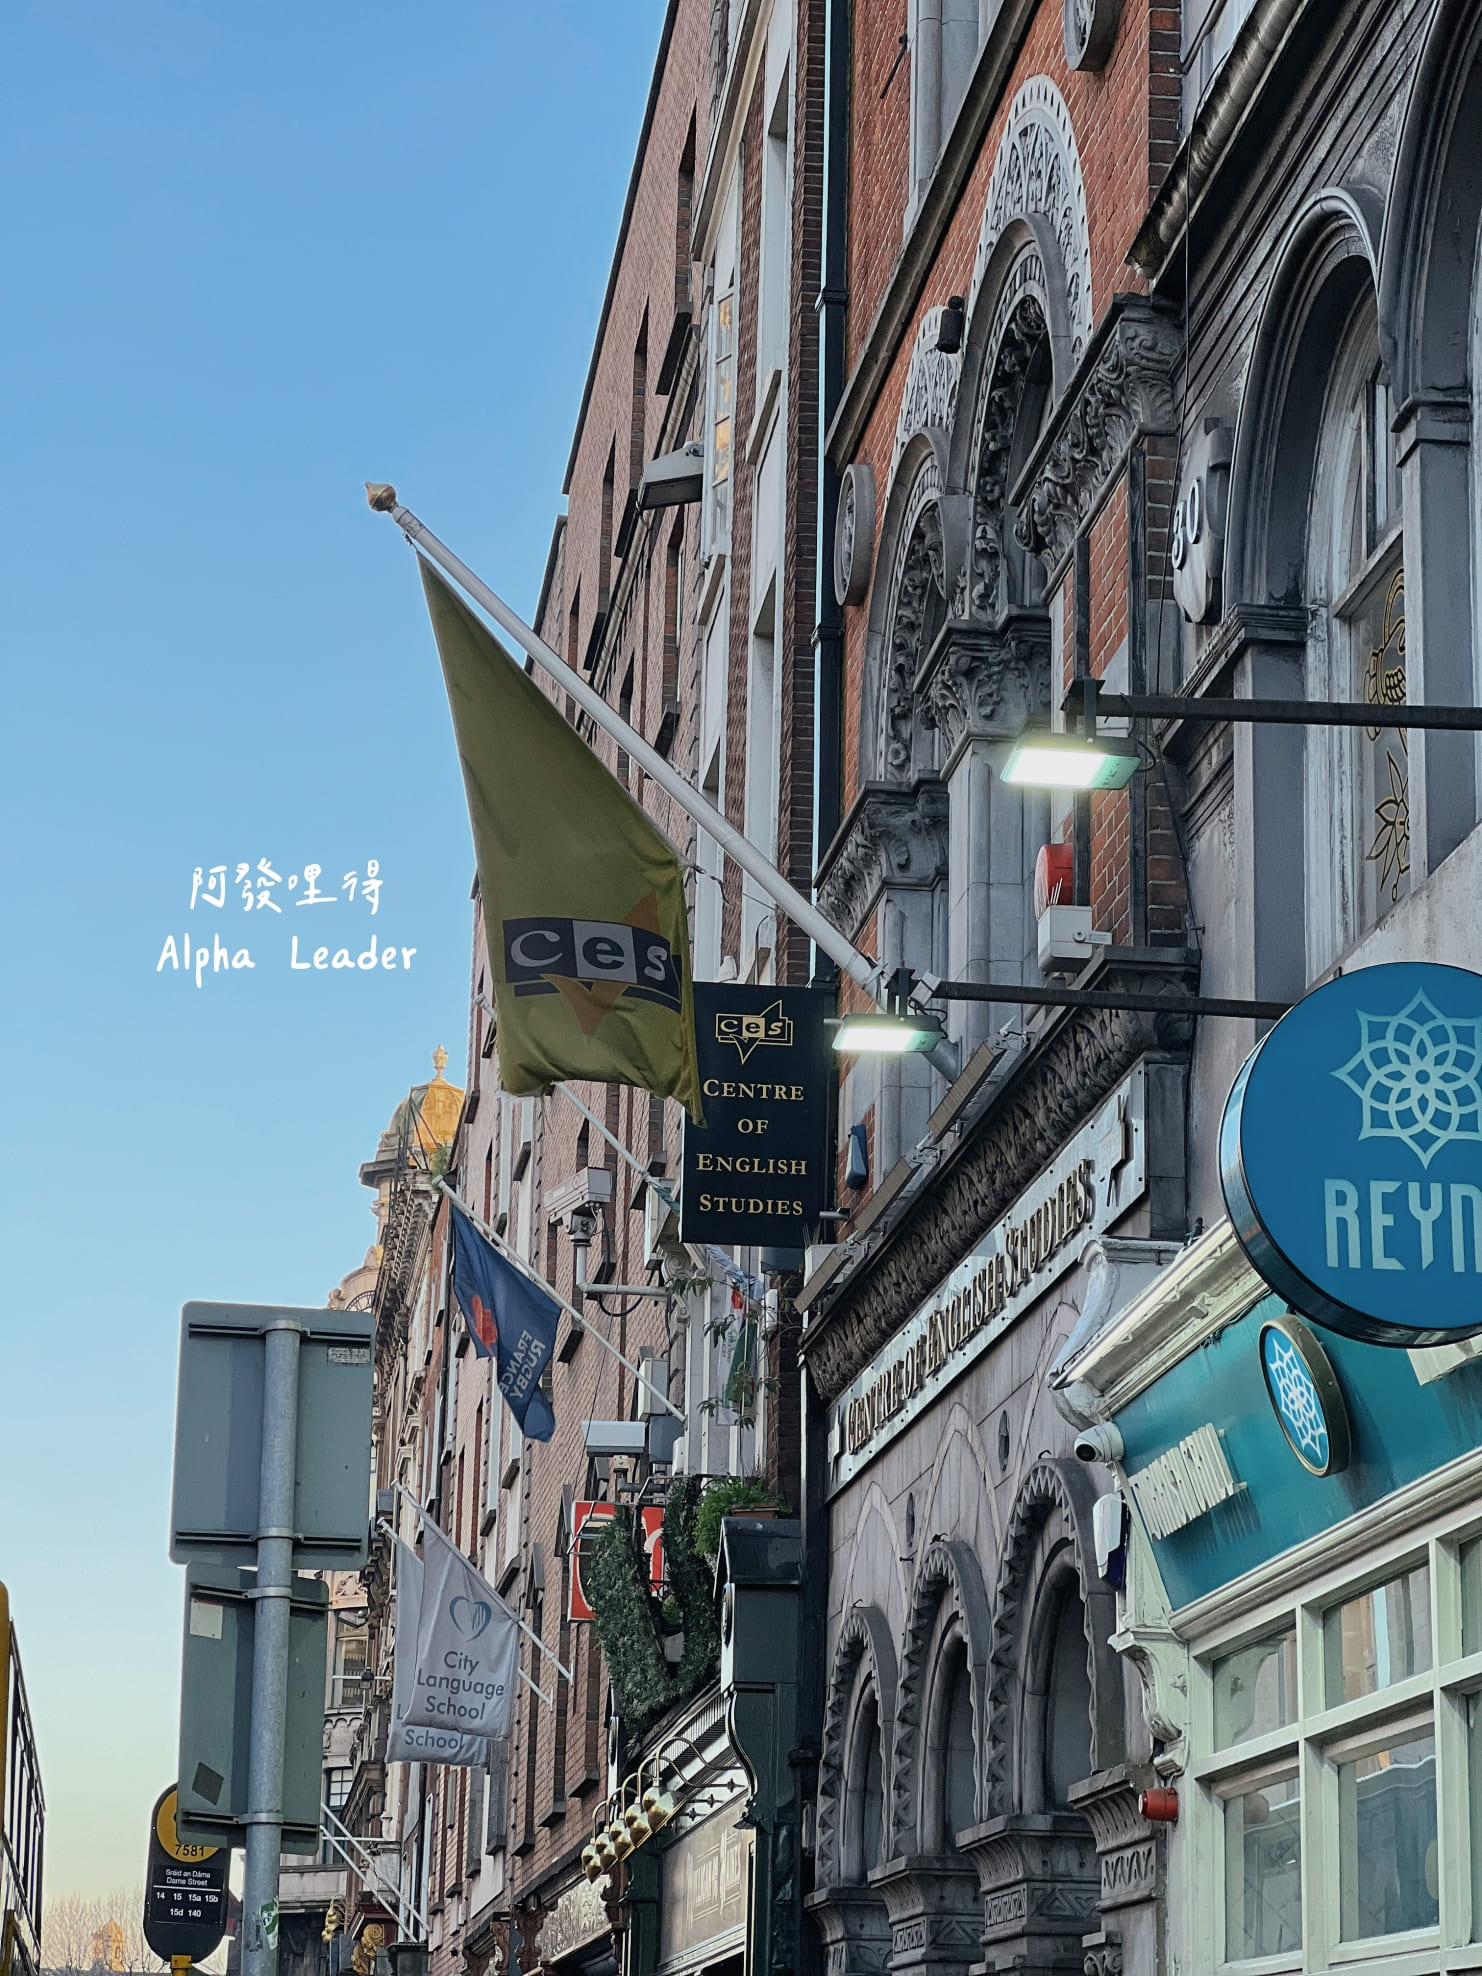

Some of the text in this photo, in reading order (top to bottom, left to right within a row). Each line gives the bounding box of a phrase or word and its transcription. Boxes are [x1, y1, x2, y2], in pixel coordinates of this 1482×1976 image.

[510, 930, 668, 981] ces
[719, 1018, 784, 1038] ces
[702, 1079, 804, 1101] CENTRE
[737, 1118, 769, 1135] OF
[696, 1153, 808, 1176] ENGLISH
[699, 1194, 804, 1216] STUDIES
[845, 1158, 1097, 1457] CENTRE OF ENGLISH STUDIES
[443, 1650, 480, 1677] City
[416, 1668, 506, 1700] Language
[424, 1695, 486, 1721] School
[404, 1728, 466, 1749] School
[175, 1844, 205, 1857] 7581
[166, 1877, 208, 1887] Dame Street
[156, 1891, 219, 1903] 14 15 15a 15b
[170, 1908, 202, 1918] 15d 140
